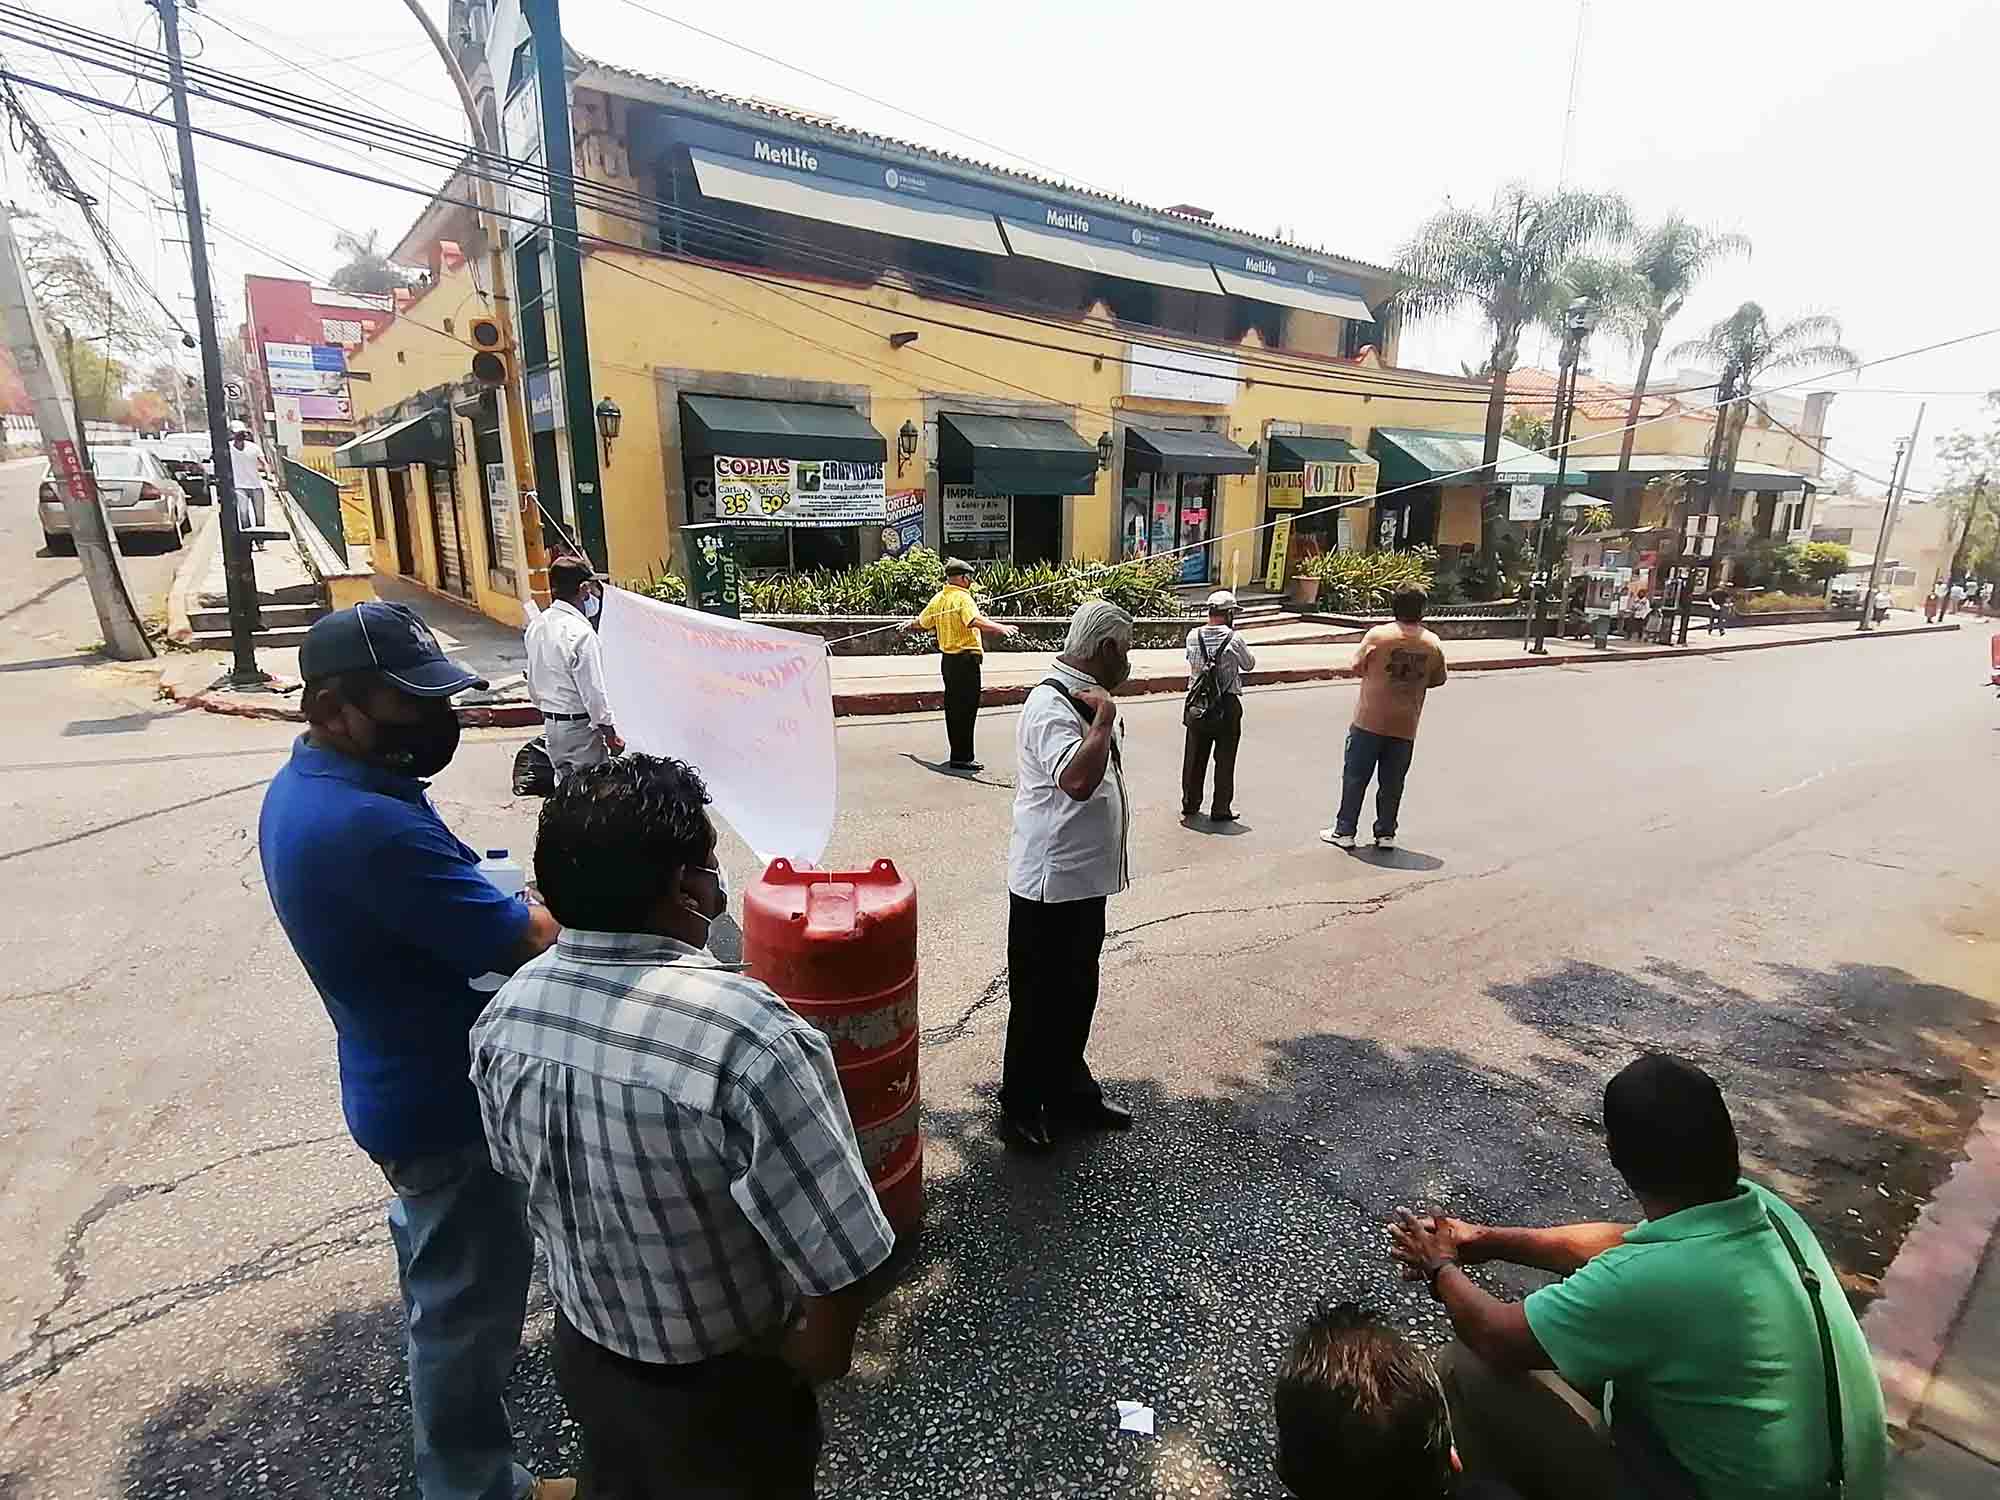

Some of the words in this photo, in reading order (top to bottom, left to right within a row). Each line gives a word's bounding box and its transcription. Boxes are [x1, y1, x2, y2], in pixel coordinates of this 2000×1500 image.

[754, 140, 818, 171] MetLife
[1045, 208, 1090, 233] MetLife
[1245, 256, 1277, 275] MetLife
[716, 457, 791, 475] COPIAS
[718, 485, 743, 494] Carta
[758, 487, 784, 496] Oficio
[886, 495, 910, 512] ORTE
[886, 503, 924, 522] ONTORNO
